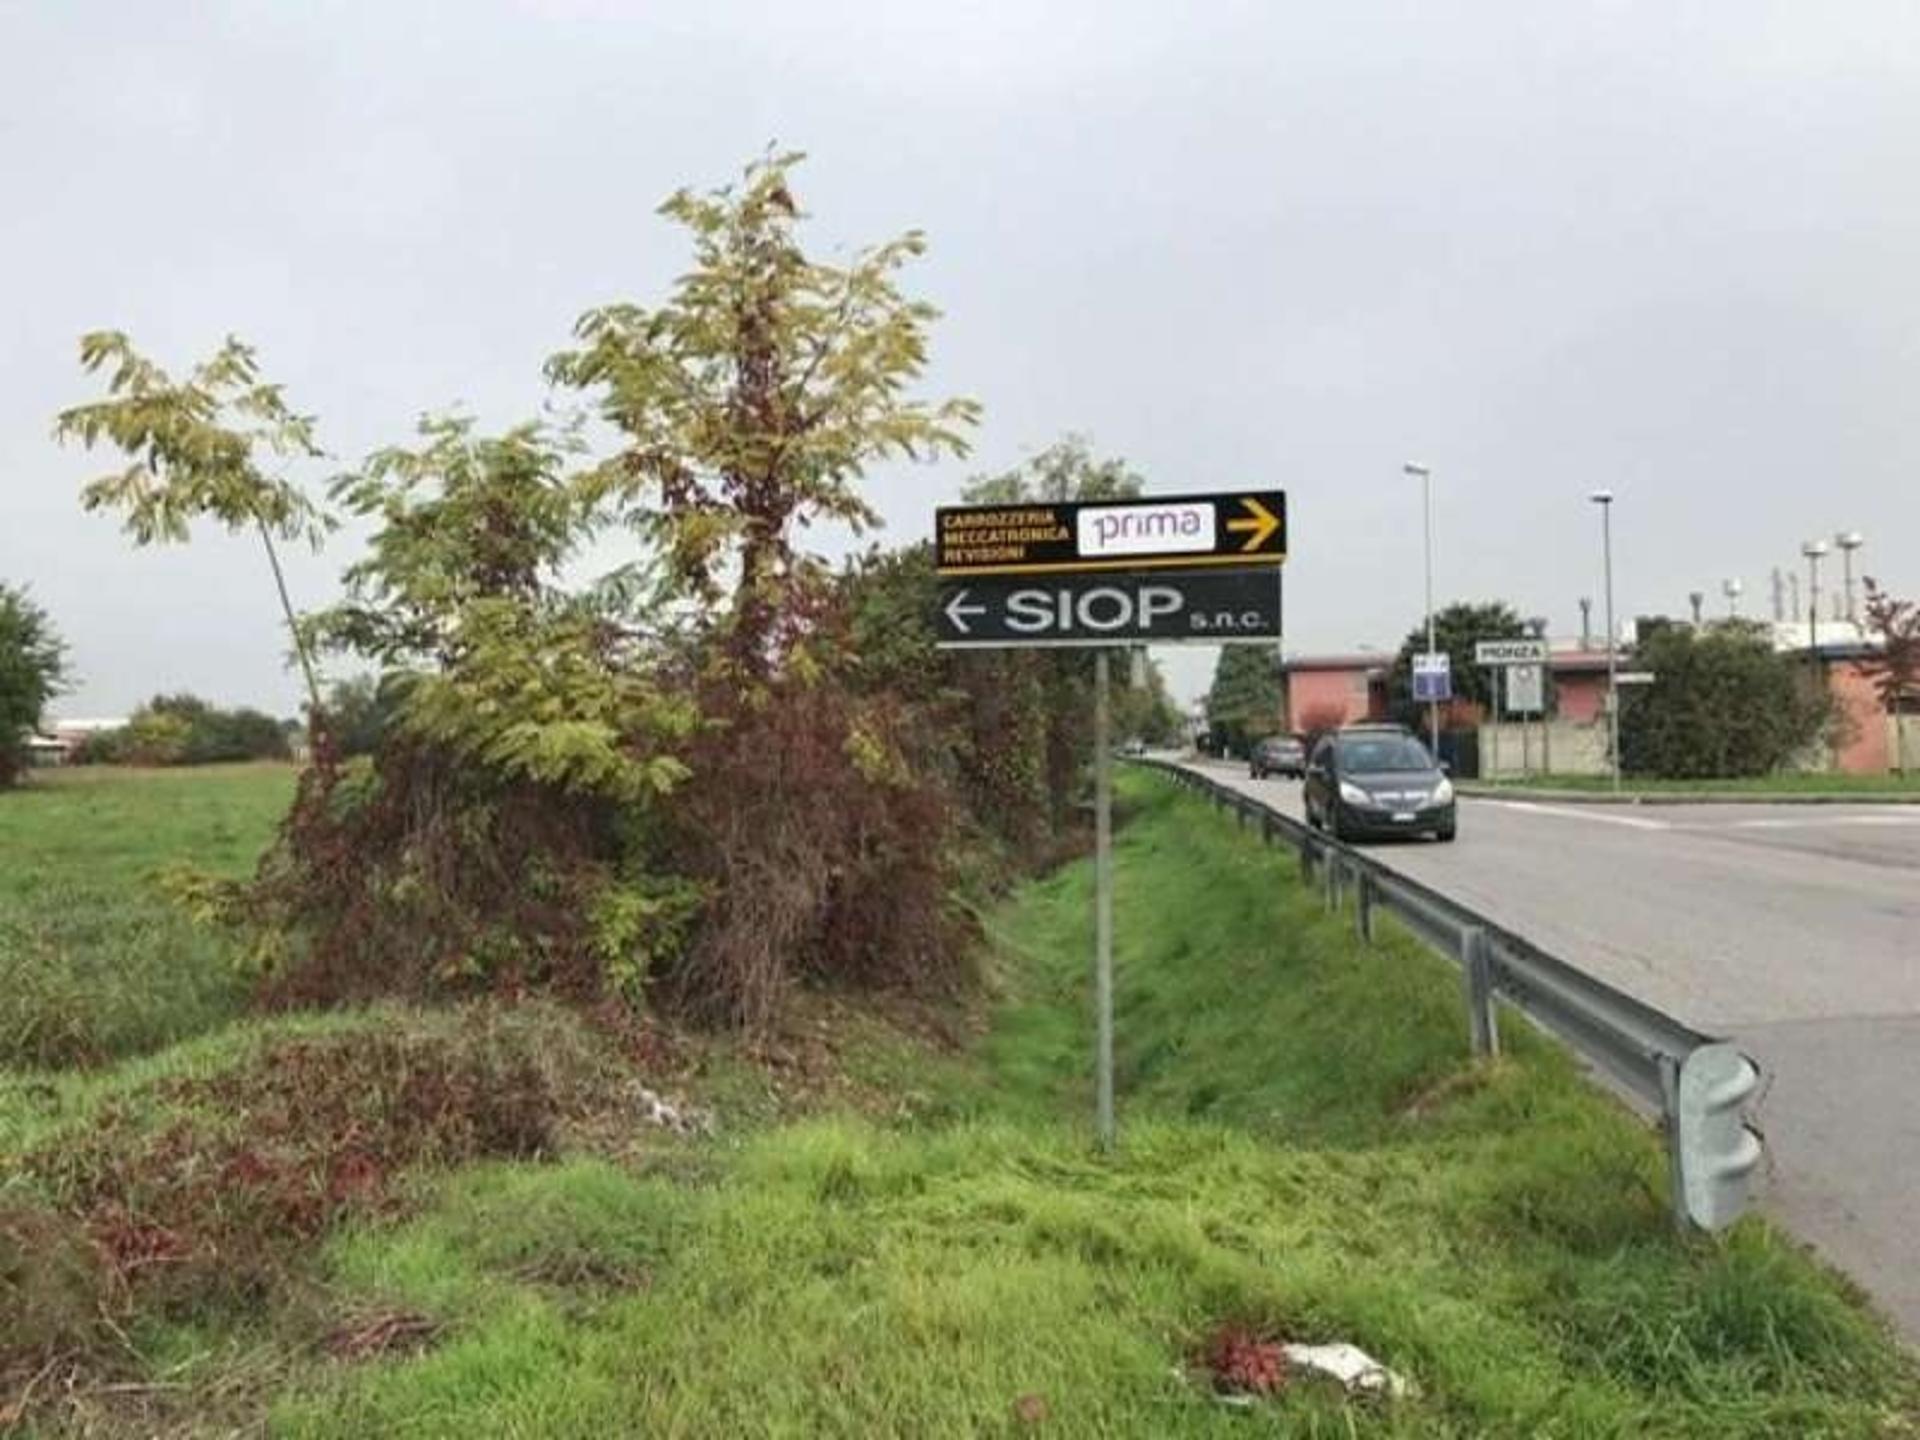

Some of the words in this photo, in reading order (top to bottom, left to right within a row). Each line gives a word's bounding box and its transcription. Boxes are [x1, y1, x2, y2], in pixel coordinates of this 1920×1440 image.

[944, 511, 1055, 528] CARROZZERIA
[944, 527, 1070, 544] MECCATRONICA
[1094, 510, 1201, 547] prima
[1004, 587, 1184, 632] SIOP
[1189, 610, 1268, 628] s.n.c.
[1480, 643, 1540, 659] MONZA
